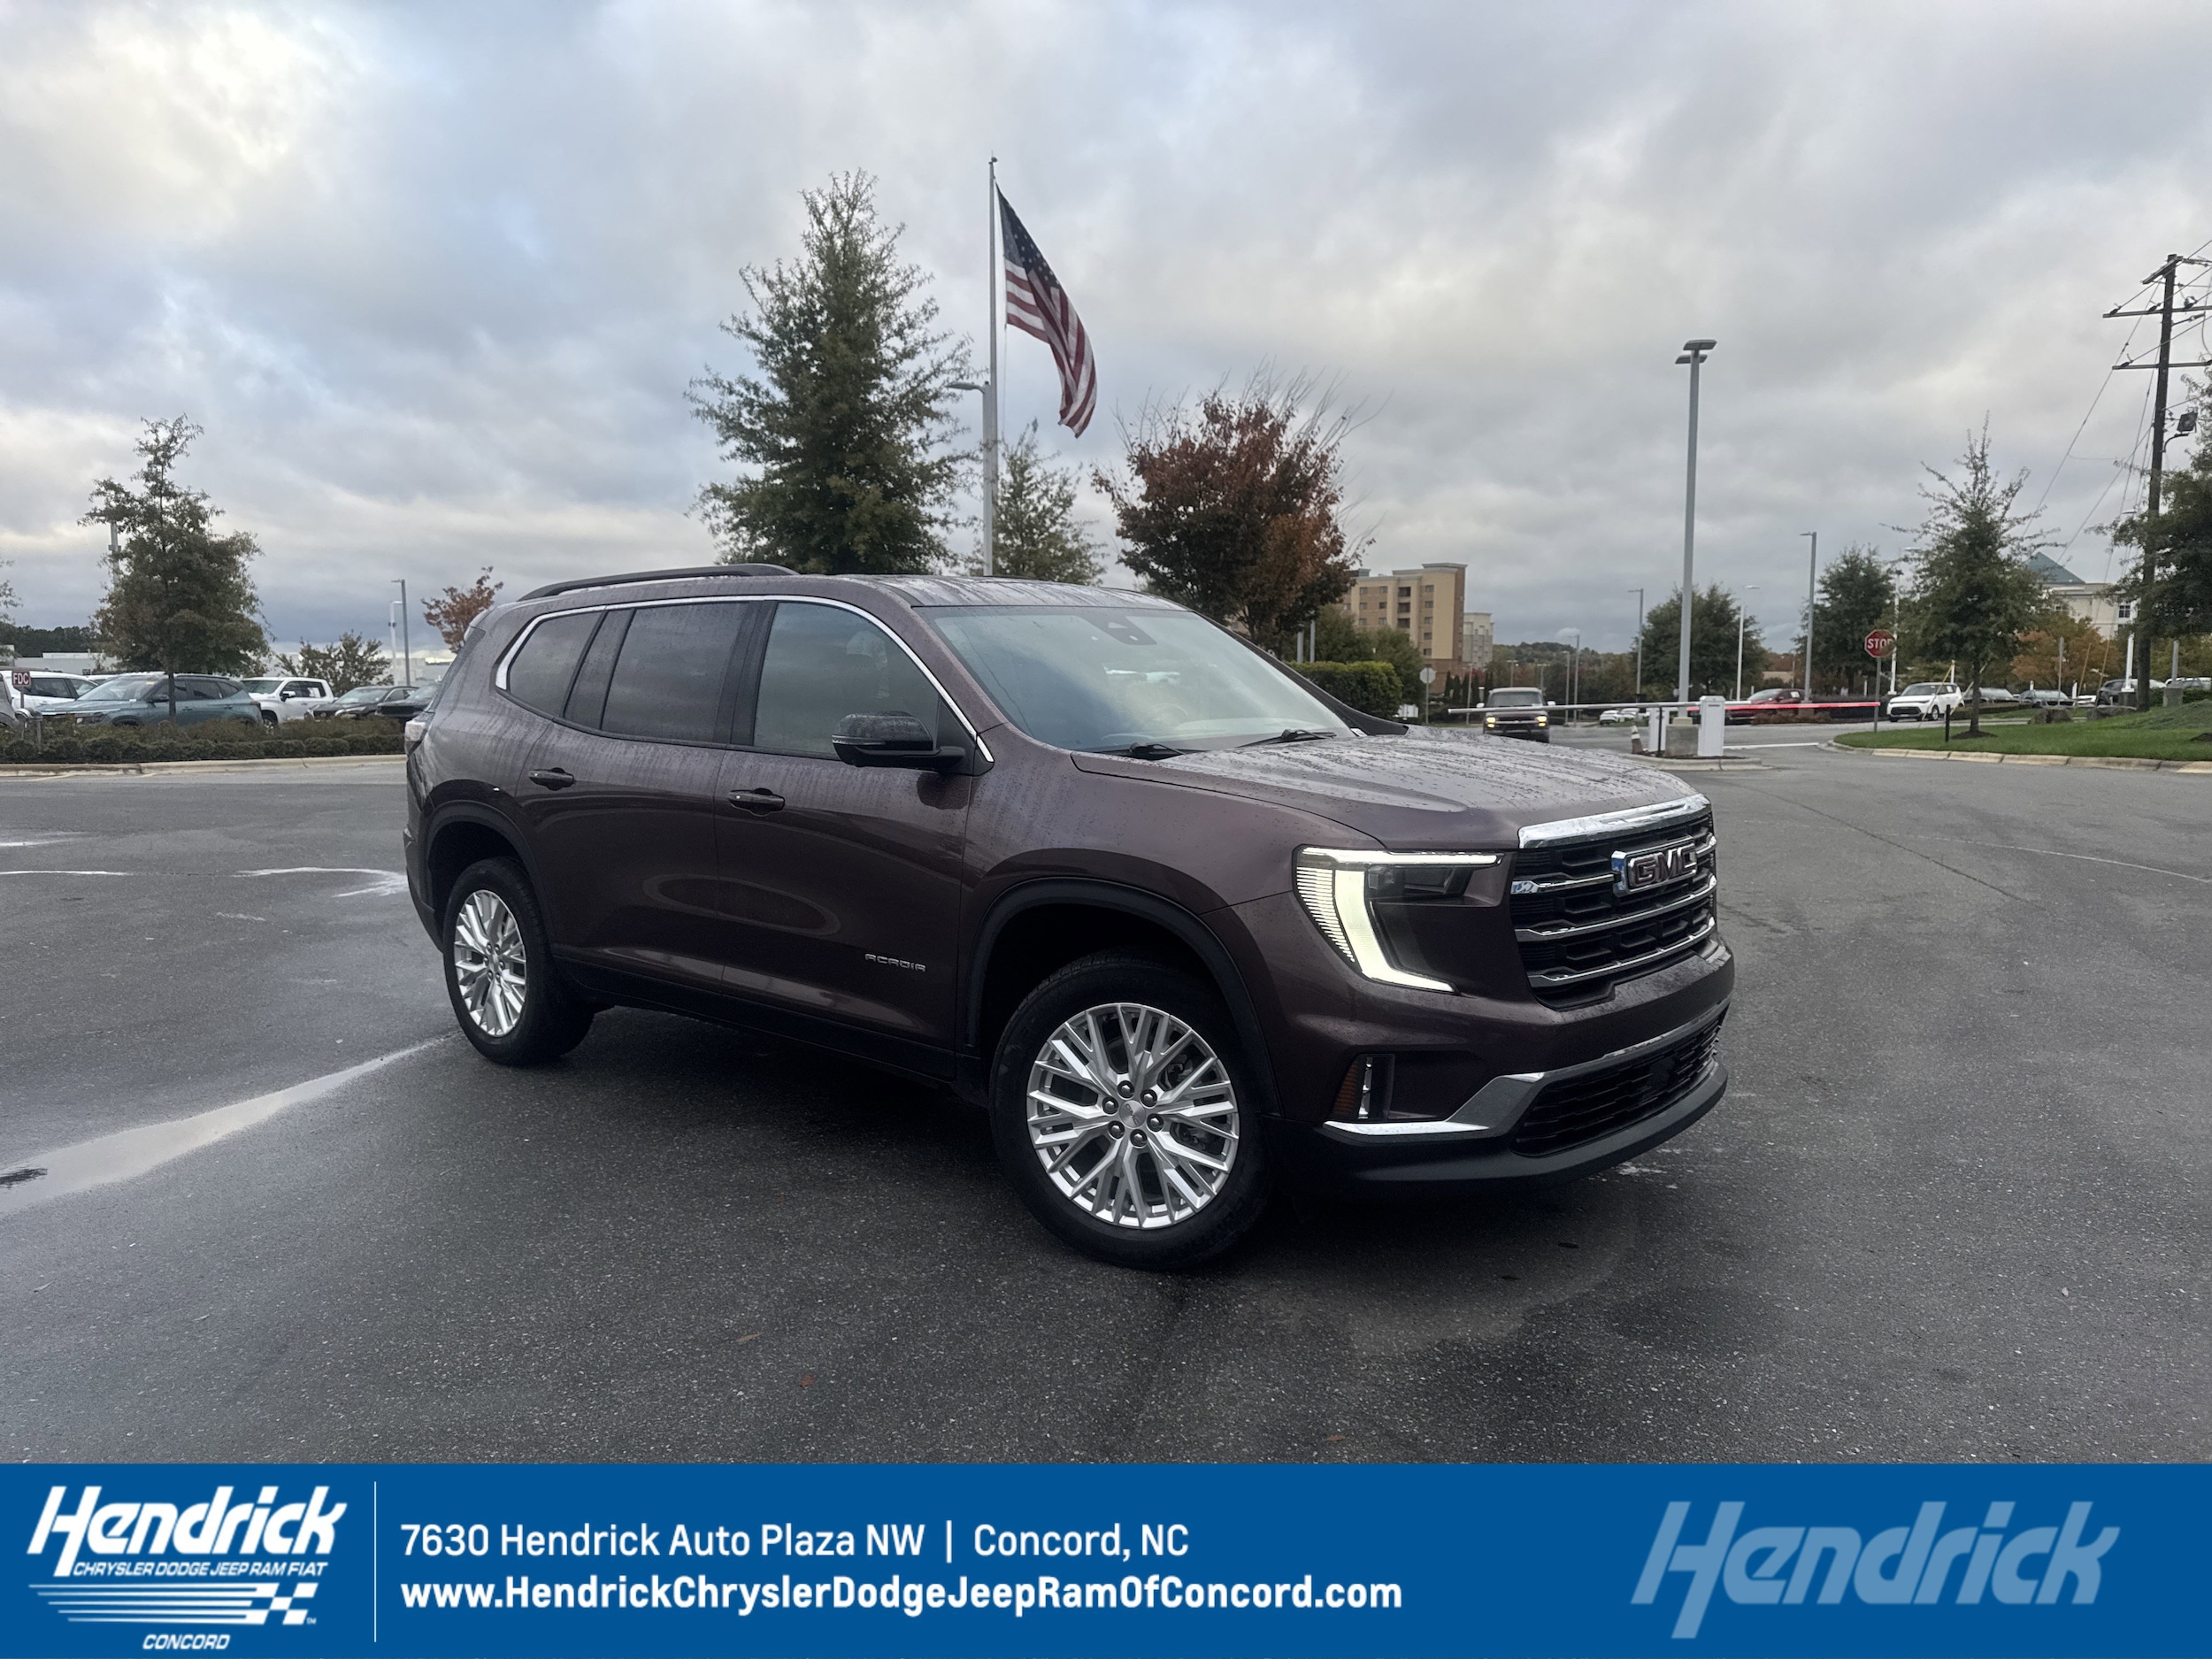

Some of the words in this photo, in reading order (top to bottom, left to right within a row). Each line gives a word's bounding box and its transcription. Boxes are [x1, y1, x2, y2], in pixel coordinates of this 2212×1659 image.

[12, 672, 29, 685] FDC
[1628, 843, 1696, 887] GMC
[864, 953, 926, 972] ACADIA
